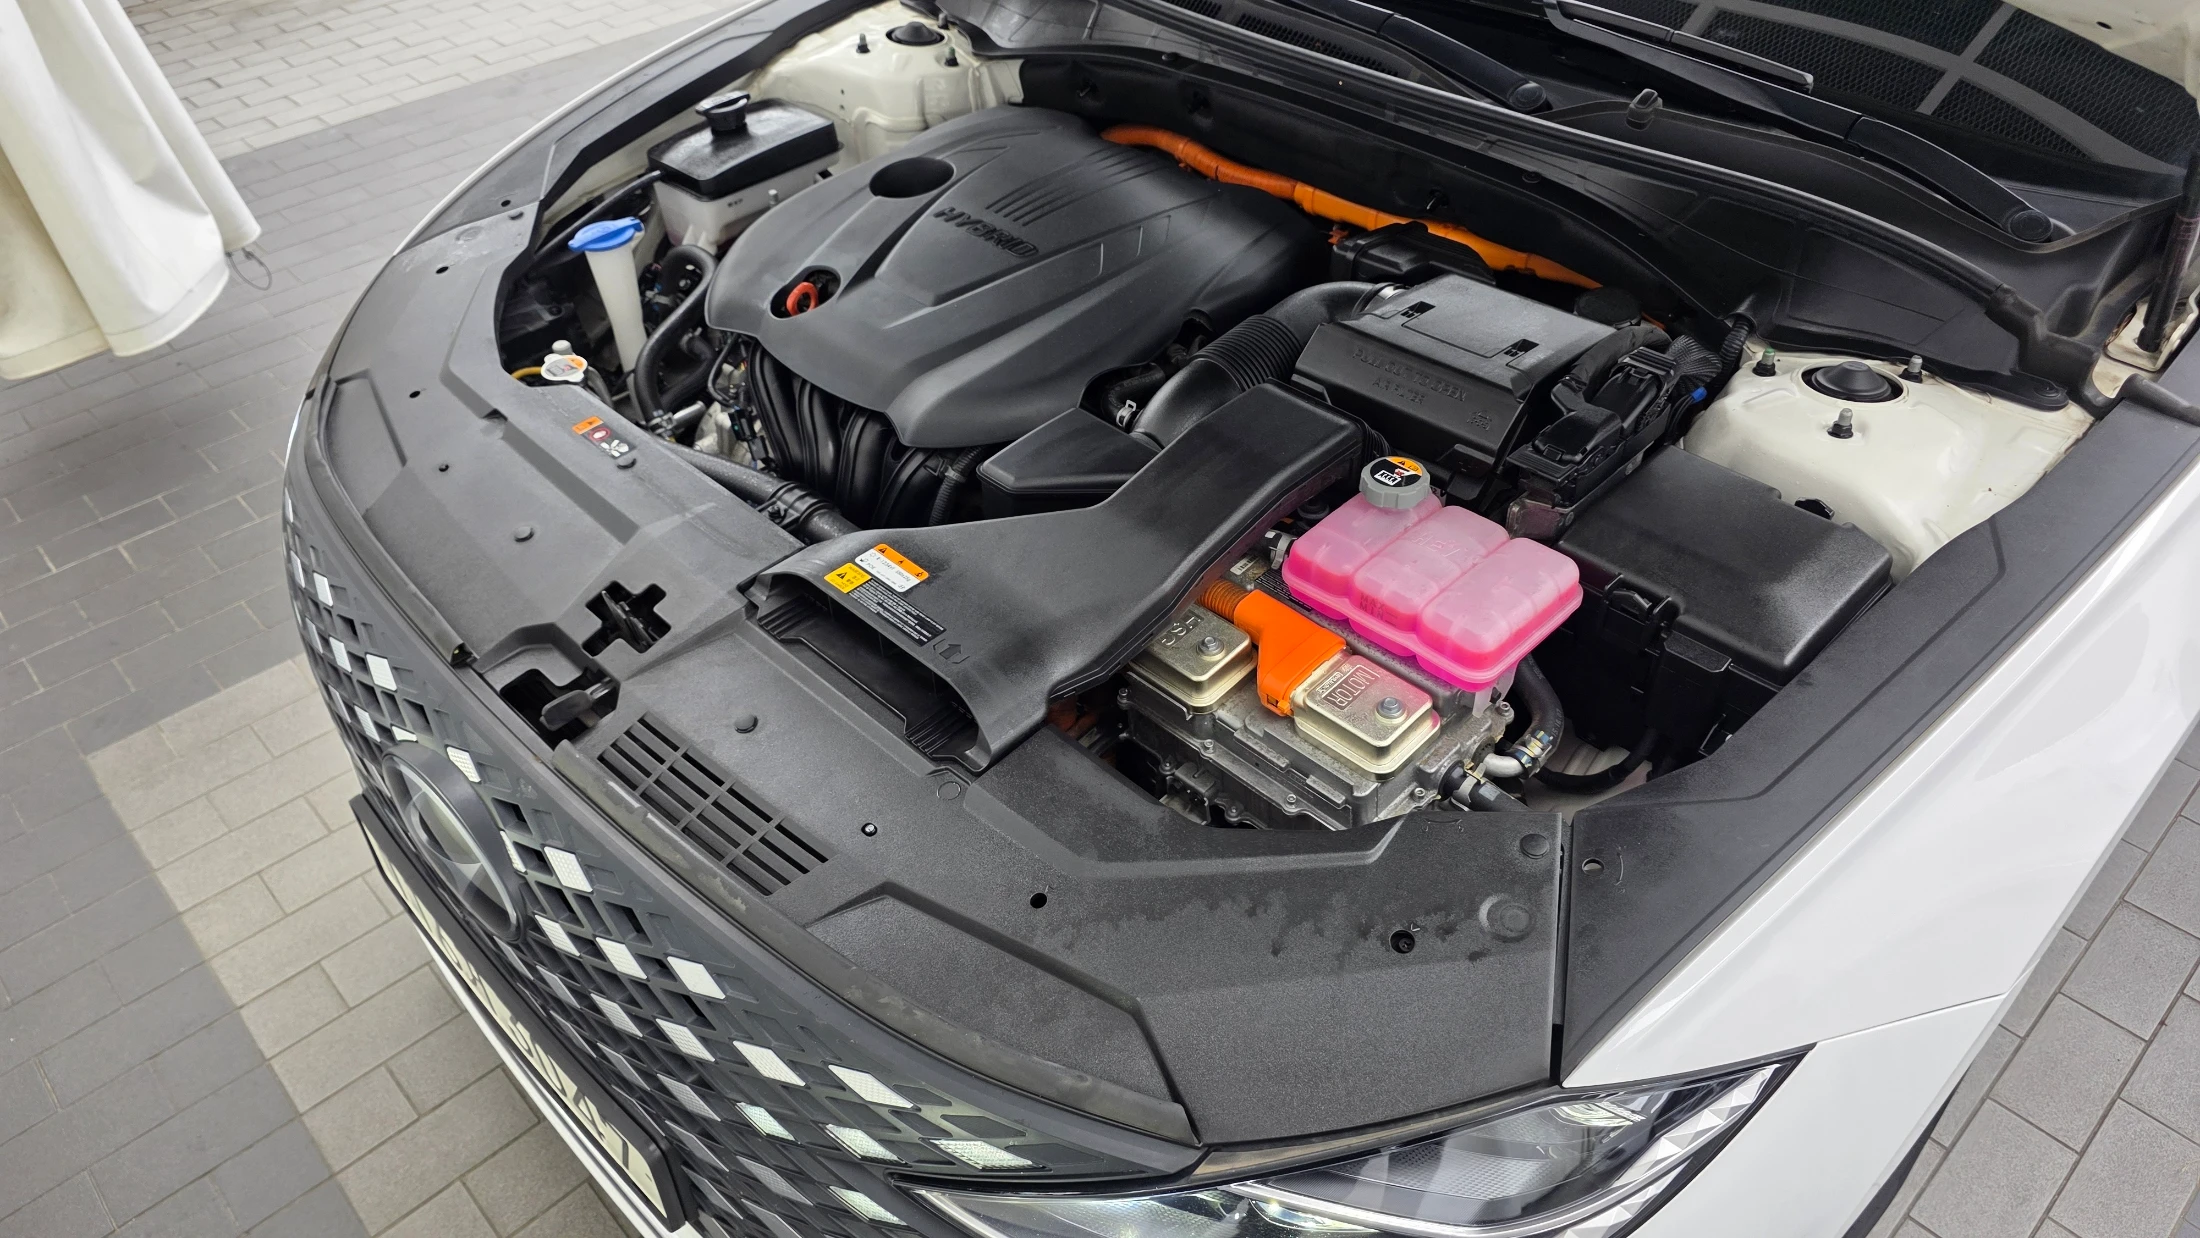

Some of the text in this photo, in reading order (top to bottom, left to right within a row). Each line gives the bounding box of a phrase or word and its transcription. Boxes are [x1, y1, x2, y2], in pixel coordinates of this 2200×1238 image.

[933, 206, 1039, 257] HYBRID
[1360, 592, 1385, 610] MAX
[1360, 601, 1383, 620] MIN
[1327, 669, 1376, 707] MOTOR
